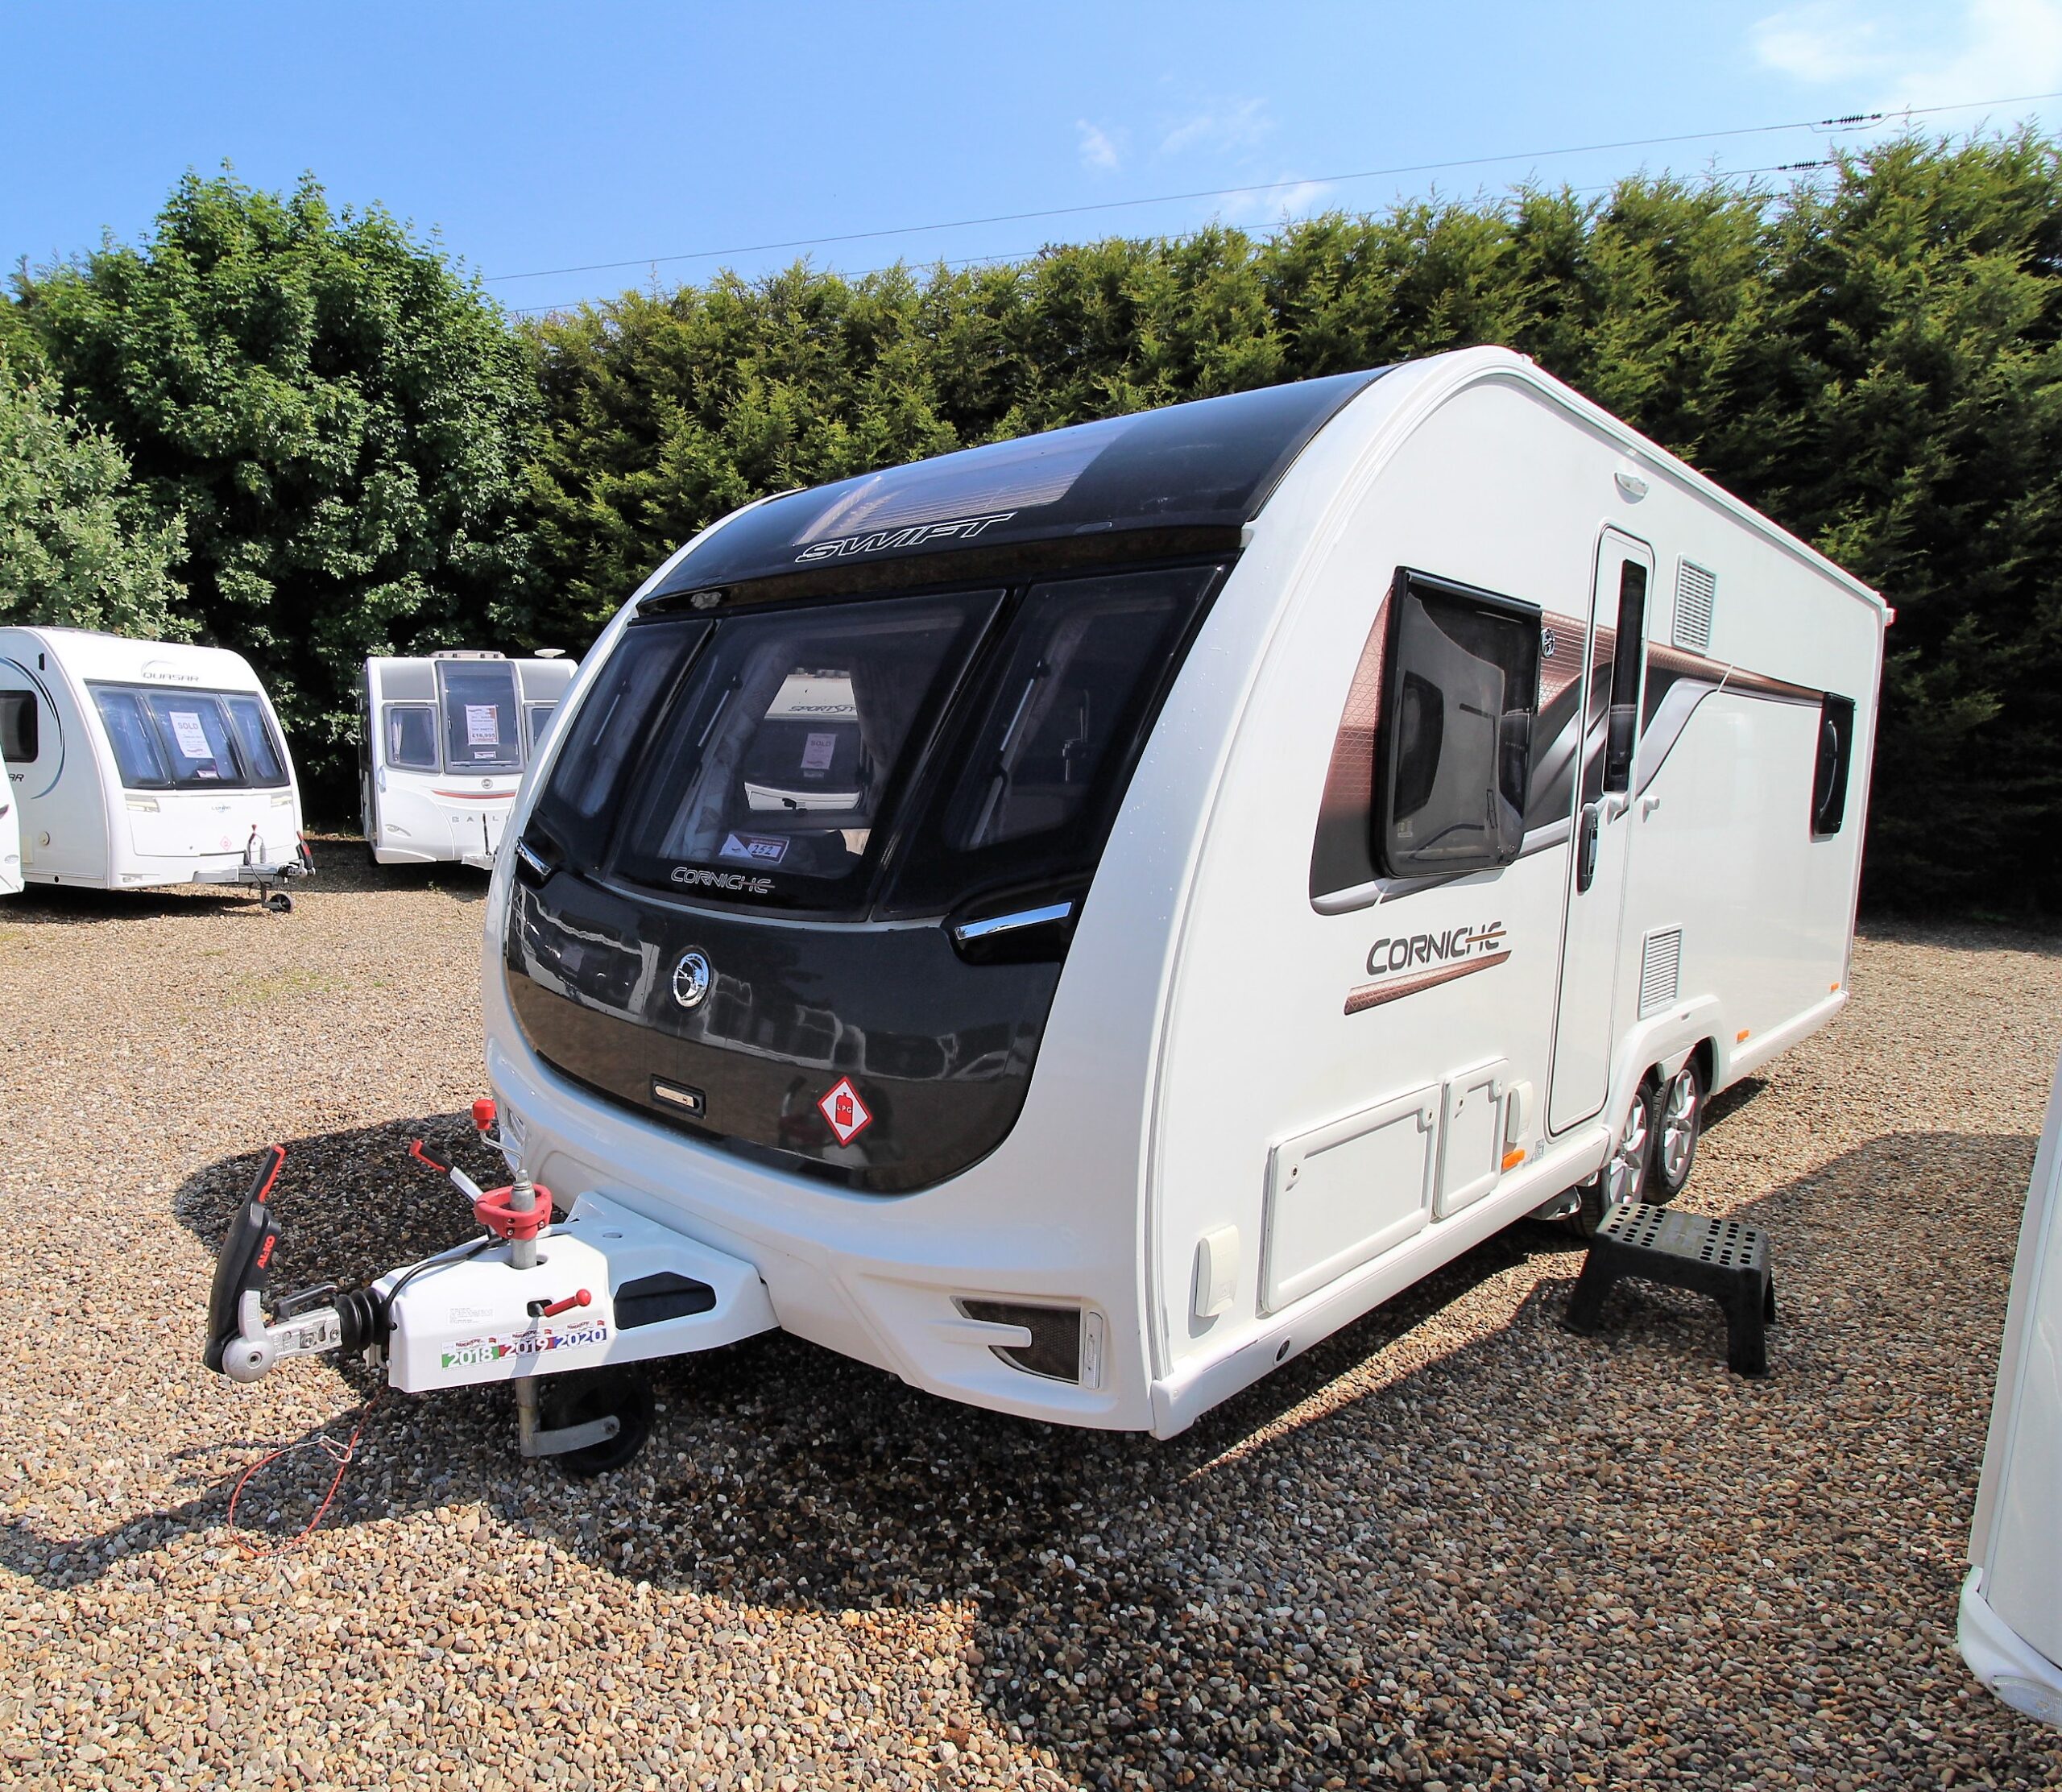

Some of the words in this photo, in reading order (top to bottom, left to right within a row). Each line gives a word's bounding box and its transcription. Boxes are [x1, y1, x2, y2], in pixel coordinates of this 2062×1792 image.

[794, 511, 1018, 563] SWIFT
[143, 672, 200, 682] QUASAR
[178, 722, 199, 730] SOLD
[752, 844, 773, 855] 252
[671, 867, 776, 894] CORNICHE
[1366, 921, 1507, 976] CORNICHE
[837, 1104, 851, 1113] LPG
[503, 1338, 549, 1358] 2019
[555, 1329, 604, 1350] 2020
[447, 1347, 494, 1368] 2018
